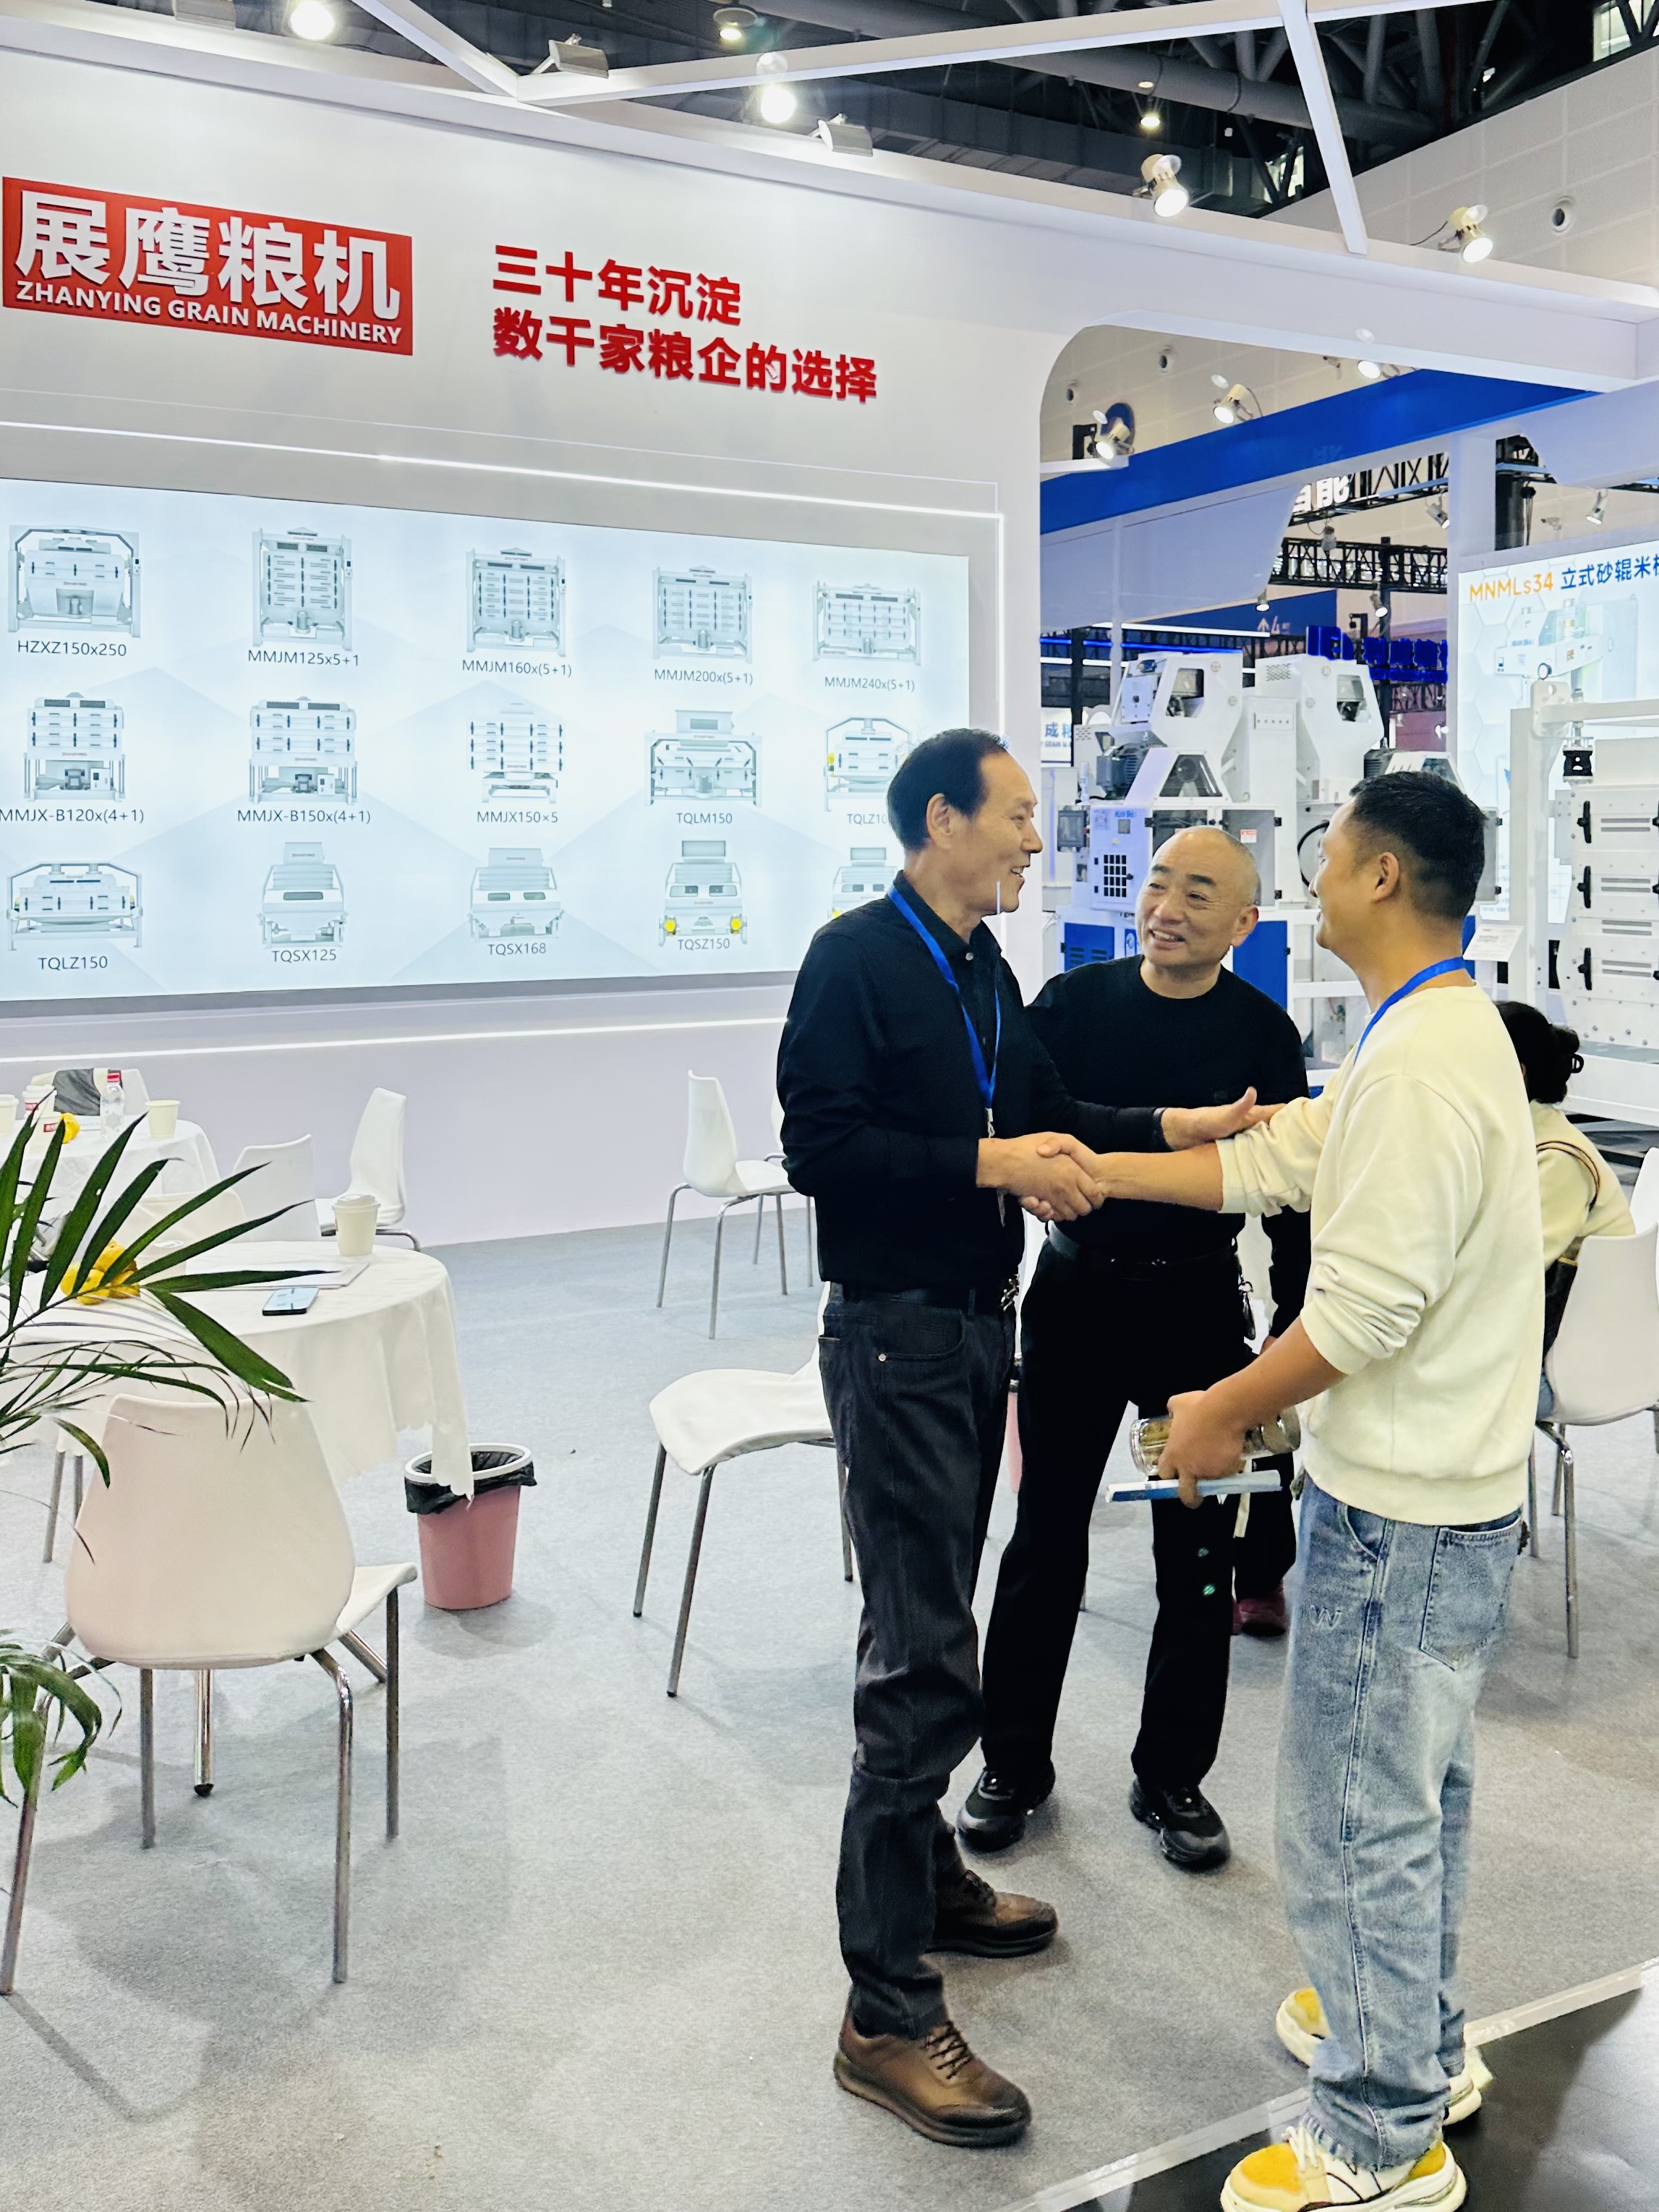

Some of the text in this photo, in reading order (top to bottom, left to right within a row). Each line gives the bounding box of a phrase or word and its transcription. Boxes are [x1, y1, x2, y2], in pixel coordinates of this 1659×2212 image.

[14, 190, 400, 320] 展鹰粮机
[493, 244, 741, 326] 三十年沉淀
[16, 280, 401, 344] ZHANYING GRAIN MACHINERY
[493, 307, 877, 403] 数千家粮企的选择
[1470, 571, 1554, 603] MNMLs34
[17, 639, 127, 657] HZXZ150x250
[247, 649, 359, 667] MMJM125x5+1
[461, 659, 573, 678] MMJM160x(5+1)
[654, 668, 754, 686] MMJM200x(5+1)
[824, 676, 916, 692] MMJM240x(5+1)
[0, 808, 145, 824] MMJX-B120x(4+1)
[237, 809, 371, 825] MMJX-B150x(4+1)
[675, 812, 733, 825] TQLM150
[487, 943, 547, 956] TQSX168
[677, 937, 730, 951] TQSZ150
[38, 956, 108, 971] TQLZ150
[270, 948, 337, 964] TQSX125
